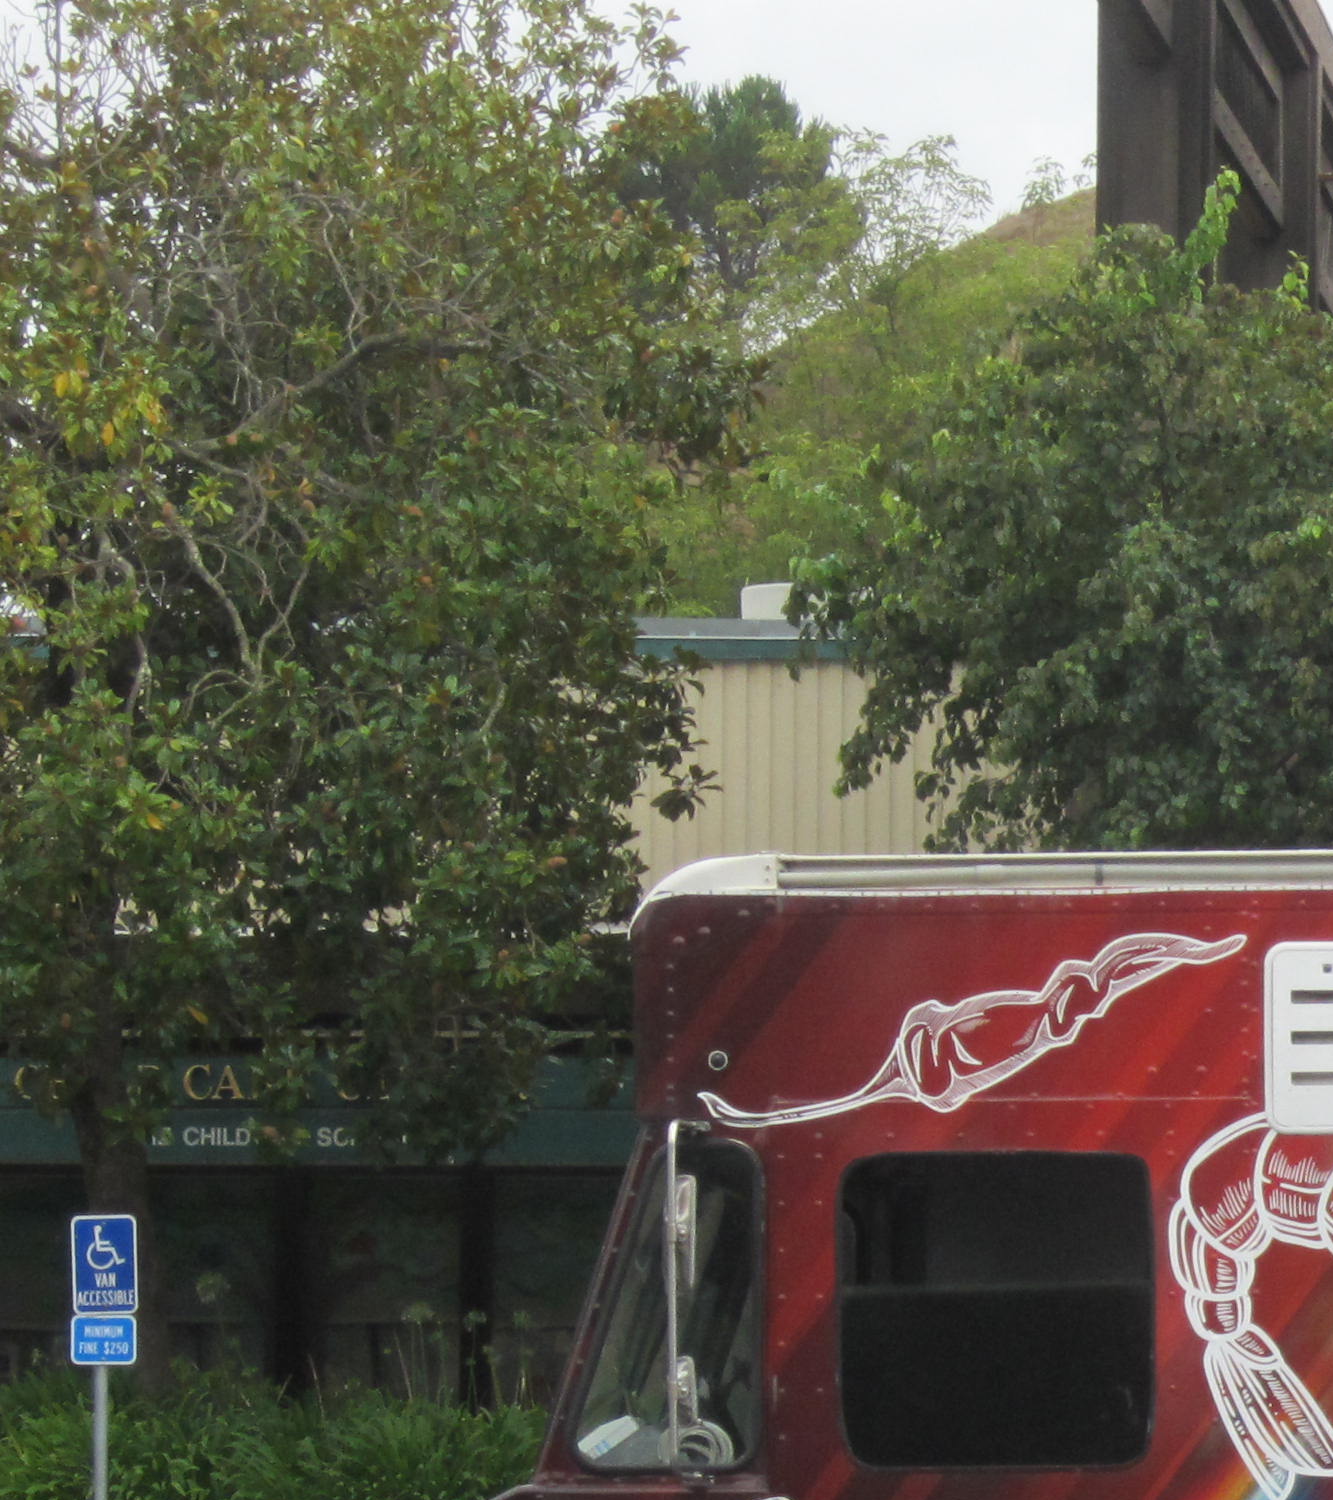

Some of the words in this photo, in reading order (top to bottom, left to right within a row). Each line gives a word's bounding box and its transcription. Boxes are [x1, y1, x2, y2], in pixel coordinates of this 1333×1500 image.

[94, 1272, 116, 1287] VAN
[77, 1289, 134, 1307] ACCESSIBLE
[84, 1325, 124, 1338] MINIMUM
[79, 1341, 99, 1354] FINE
[103, 1341, 129, 1355] $250
